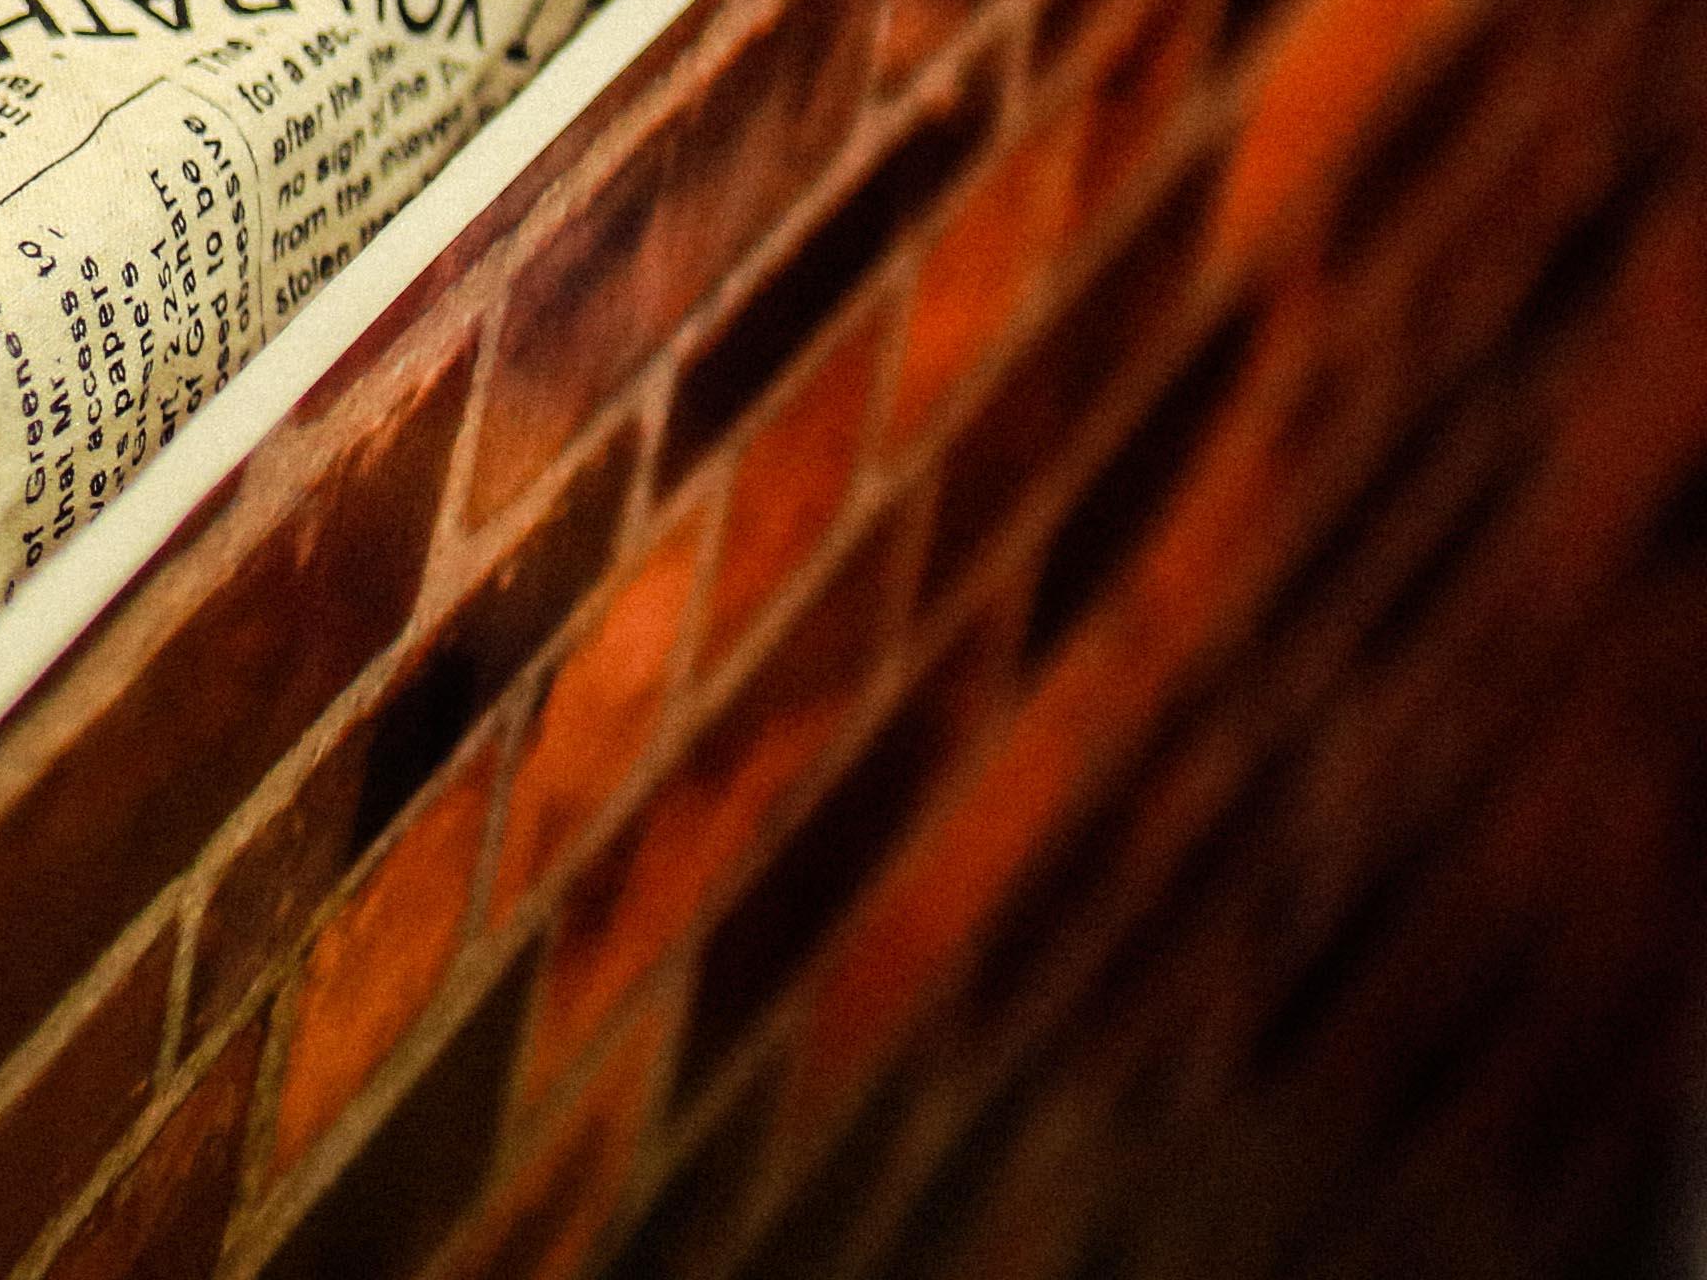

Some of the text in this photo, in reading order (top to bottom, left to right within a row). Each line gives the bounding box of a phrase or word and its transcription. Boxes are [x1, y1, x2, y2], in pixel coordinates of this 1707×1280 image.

[181, 157, 215, 219] be
[16, 239, 60, 280] to
[148, 167, 206, 359] Graham
[59, 289, 105, 454] access
[80, 255, 136, 418] papers
[53, 446, 77, 541] that
[22, 524, 45, 569] of
